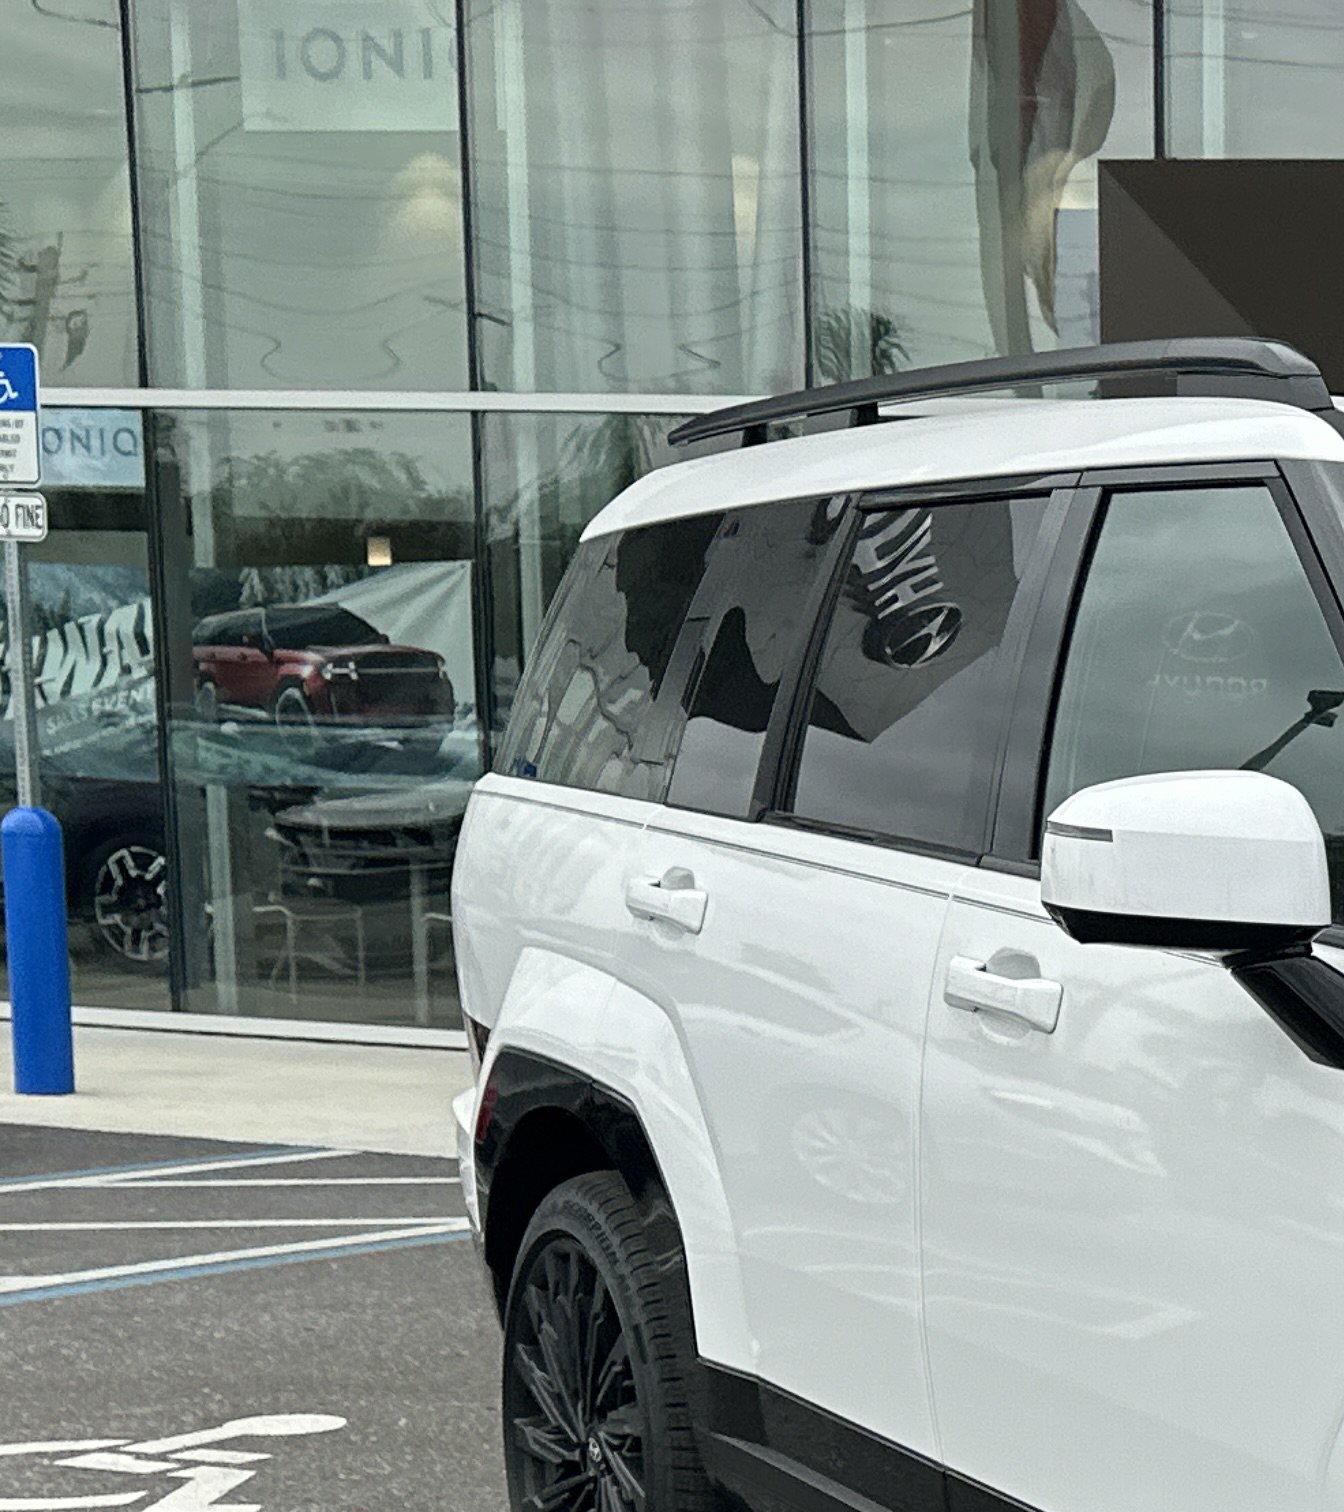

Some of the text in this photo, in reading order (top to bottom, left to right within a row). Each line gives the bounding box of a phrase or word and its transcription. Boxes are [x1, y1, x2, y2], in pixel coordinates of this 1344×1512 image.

[274, 27, 456, 82] IONI
[41, 427, 138, 456] ONIQ
[15, 503, 44, 529] FINE
